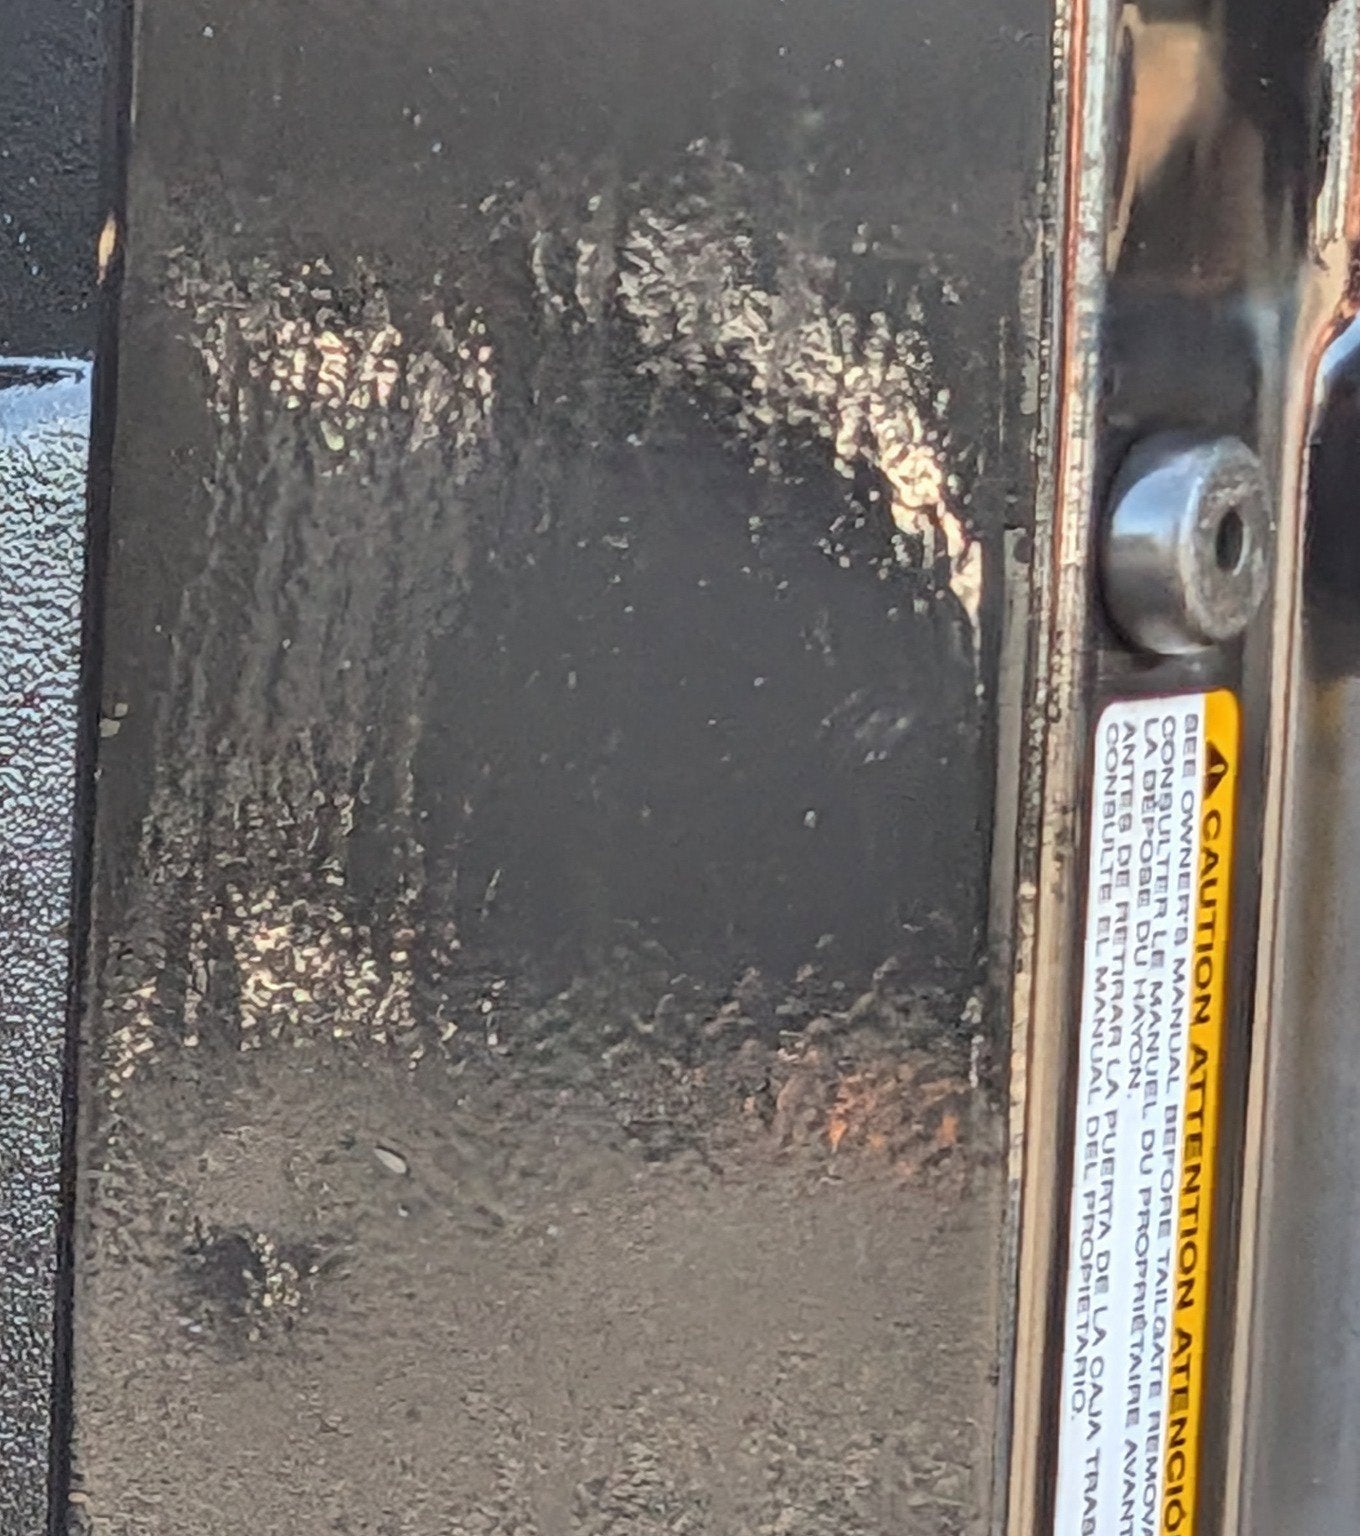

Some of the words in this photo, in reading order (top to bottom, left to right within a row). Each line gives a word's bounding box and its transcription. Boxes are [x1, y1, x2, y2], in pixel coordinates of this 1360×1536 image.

[1117, 722, 1135, 834] ANTES
[1143, 718, 1158, 759] LA
[1181, 714, 1197, 778] SEE
[1098, 722, 1118, 904] CONSULTE
[1114, 845, 1130, 888] DE
[1152, 716, 1175, 919] CONSULTER
[1173, 790, 1193, 946] OWNER'S
[1095, 916, 1110, 956] EL
[1106, 902, 1128, 1047] RETIRAR
[1133, 921, 1149, 966] DU
[1150, 931, 1166, 970] LE
[1190, 809, 1220, 1026] CAUTION
[1087, 967, 1108, 1105] MANUAL
[1104, 1059, 1119, 1100] LA
[1126, 979, 1146, 1099] HAYON.
[1141, 981, 1162, 1119] MANUEL
[1165, 957, 1184, 1094] MANUAL
[1083, 1116, 1098, 1181] DEL
[1096, 1110, 1117, 1240] PUERTA
[1139, 1129, 1154, 1175] DU
[1156, 1105, 1177, 1239] BEFORE
[1175, 1043, 1207, 1311] ATTENTION
[1070, 1190, 1095, 1421] PROPIETARIO.
[1091, 1306, 1107, 1346] LA
[1094, 1250, 1109, 1294] DE
[1148, 1249, 1169, 1399] TAILGATE
[1085, 1356, 1103, 1441] CAJA
